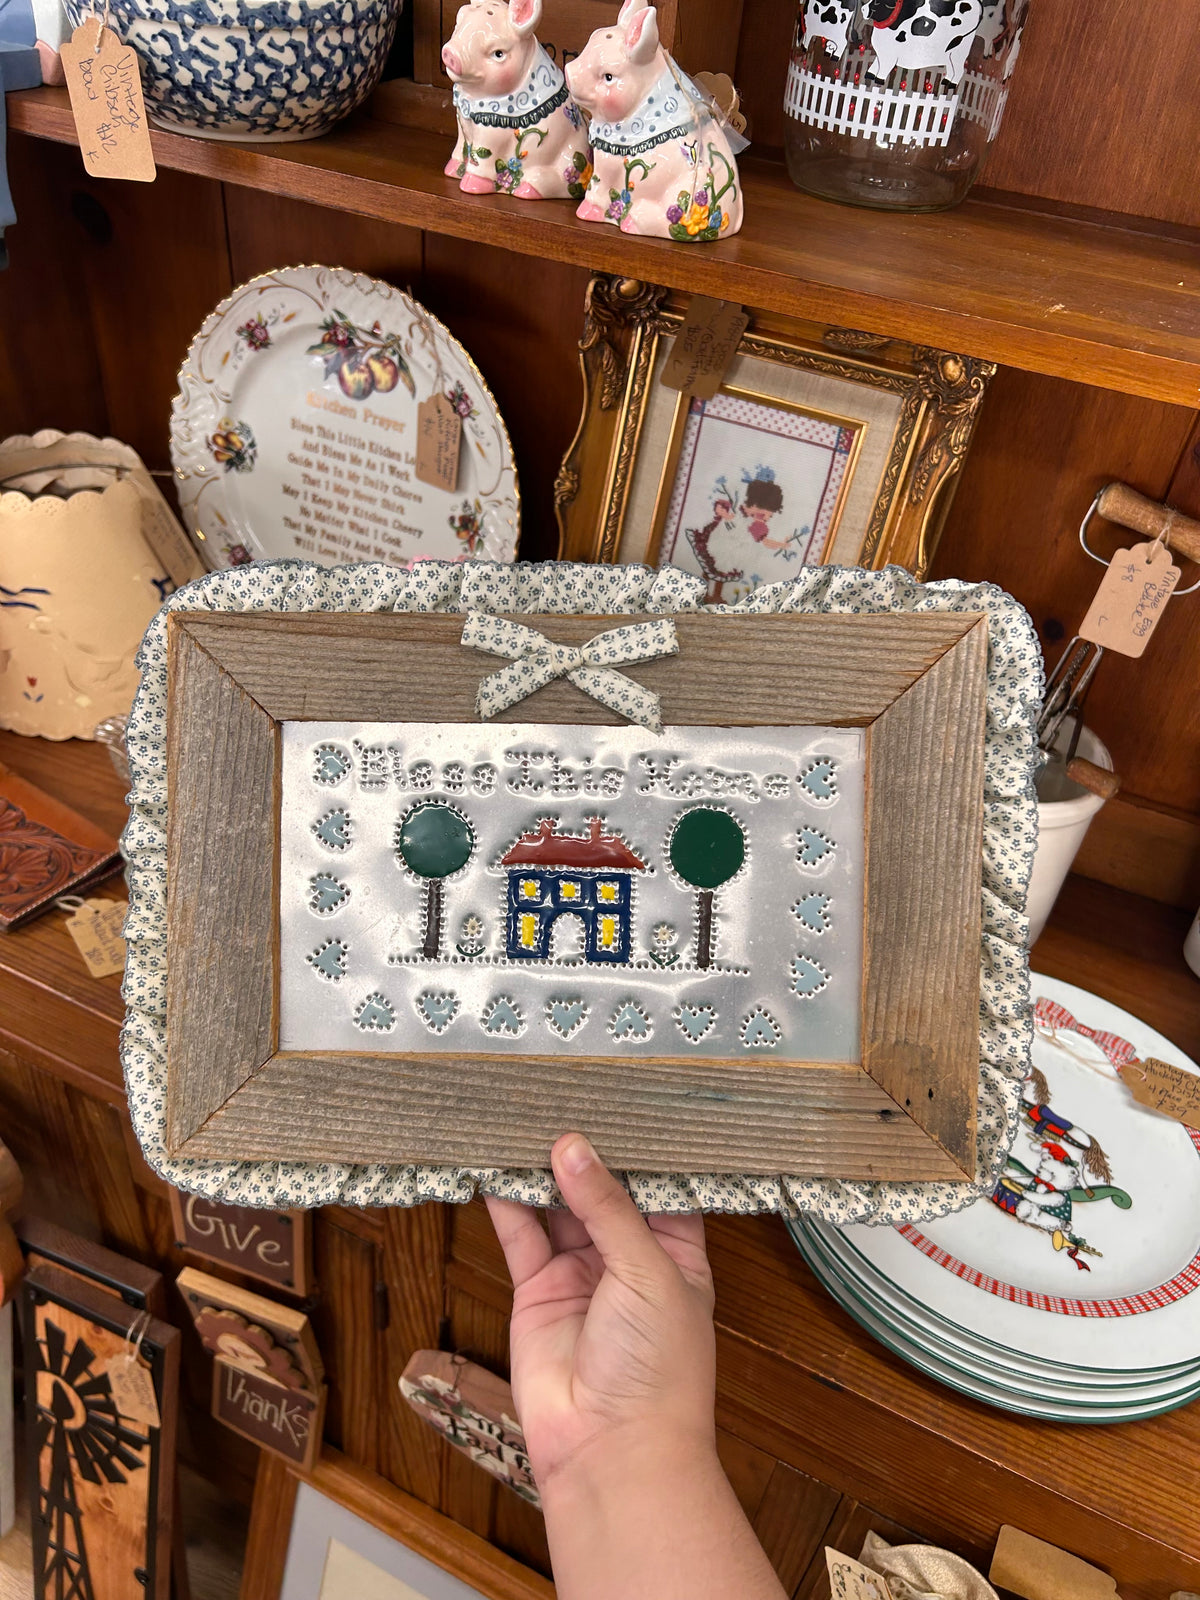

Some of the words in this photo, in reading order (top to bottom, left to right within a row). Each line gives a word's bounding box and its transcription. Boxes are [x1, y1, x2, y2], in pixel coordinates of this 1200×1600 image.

[100, 65, 121, 128] Gibson
[117, 54, 141, 133] Vintage
[96, 122, 117, 154] $12
[306, 391, 357, 419] Kitchen
[363, 408, 406, 433] Prayer
[290, 417, 314, 434] Bless
[317, 425, 335, 440] This
[338, 432, 366, 450] Little
[368, 441, 402, 461] Kitchen
[287, 452, 313, 468] Guide
[316, 460, 329, 473] Me
[333, 466, 344, 478] In
[347, 470, 361, 484] My
[363, 475, 389, 493] Daily
[392, 485, 422, 503] Chores
[302, 440, 320, 453] And
[322, 444, 347, 462] Bless
[349, 453, 362, 466] Me
[365, 459, 377, 471] As
[388, 464, 410, 482] Work
[301, 473, 321, 488] That
[333, 483, 351, 498] May
[282, 484, 299, 500] May
[312, 493, 333, 509] Keep
[337, 501, 350, 514] My
[353, 506, 388, 527] Kitchen
[392, 520, 424, 539] Cheery
[300, 505, 312, 518] No
[314, 510, 345, 528] Matter
[348, 520, 370, 537] What
[381, 532, 402, 548] Cook
[283, 516, 301, 530] That
[304, 523, 317, 537] My
[320, 528, 351, 548] Family
[354, 541, 371, 554] And
[373, 546, 386, 559] My
[293, 535, 315, 552] Will
[318, 544, 337, 558] Love
[1121, 564, 1141, 582] $8
[1151, 571, 1176, 609] Vintage
[1133, 617, 1152, 637] Egg
[1148, 1084, 1156, 1093] 4
[1156, 1098, 1187, 1117] $39
[186, 1194, 290, 1267] Give
[222, 1365, 310, 1447] Thanks
